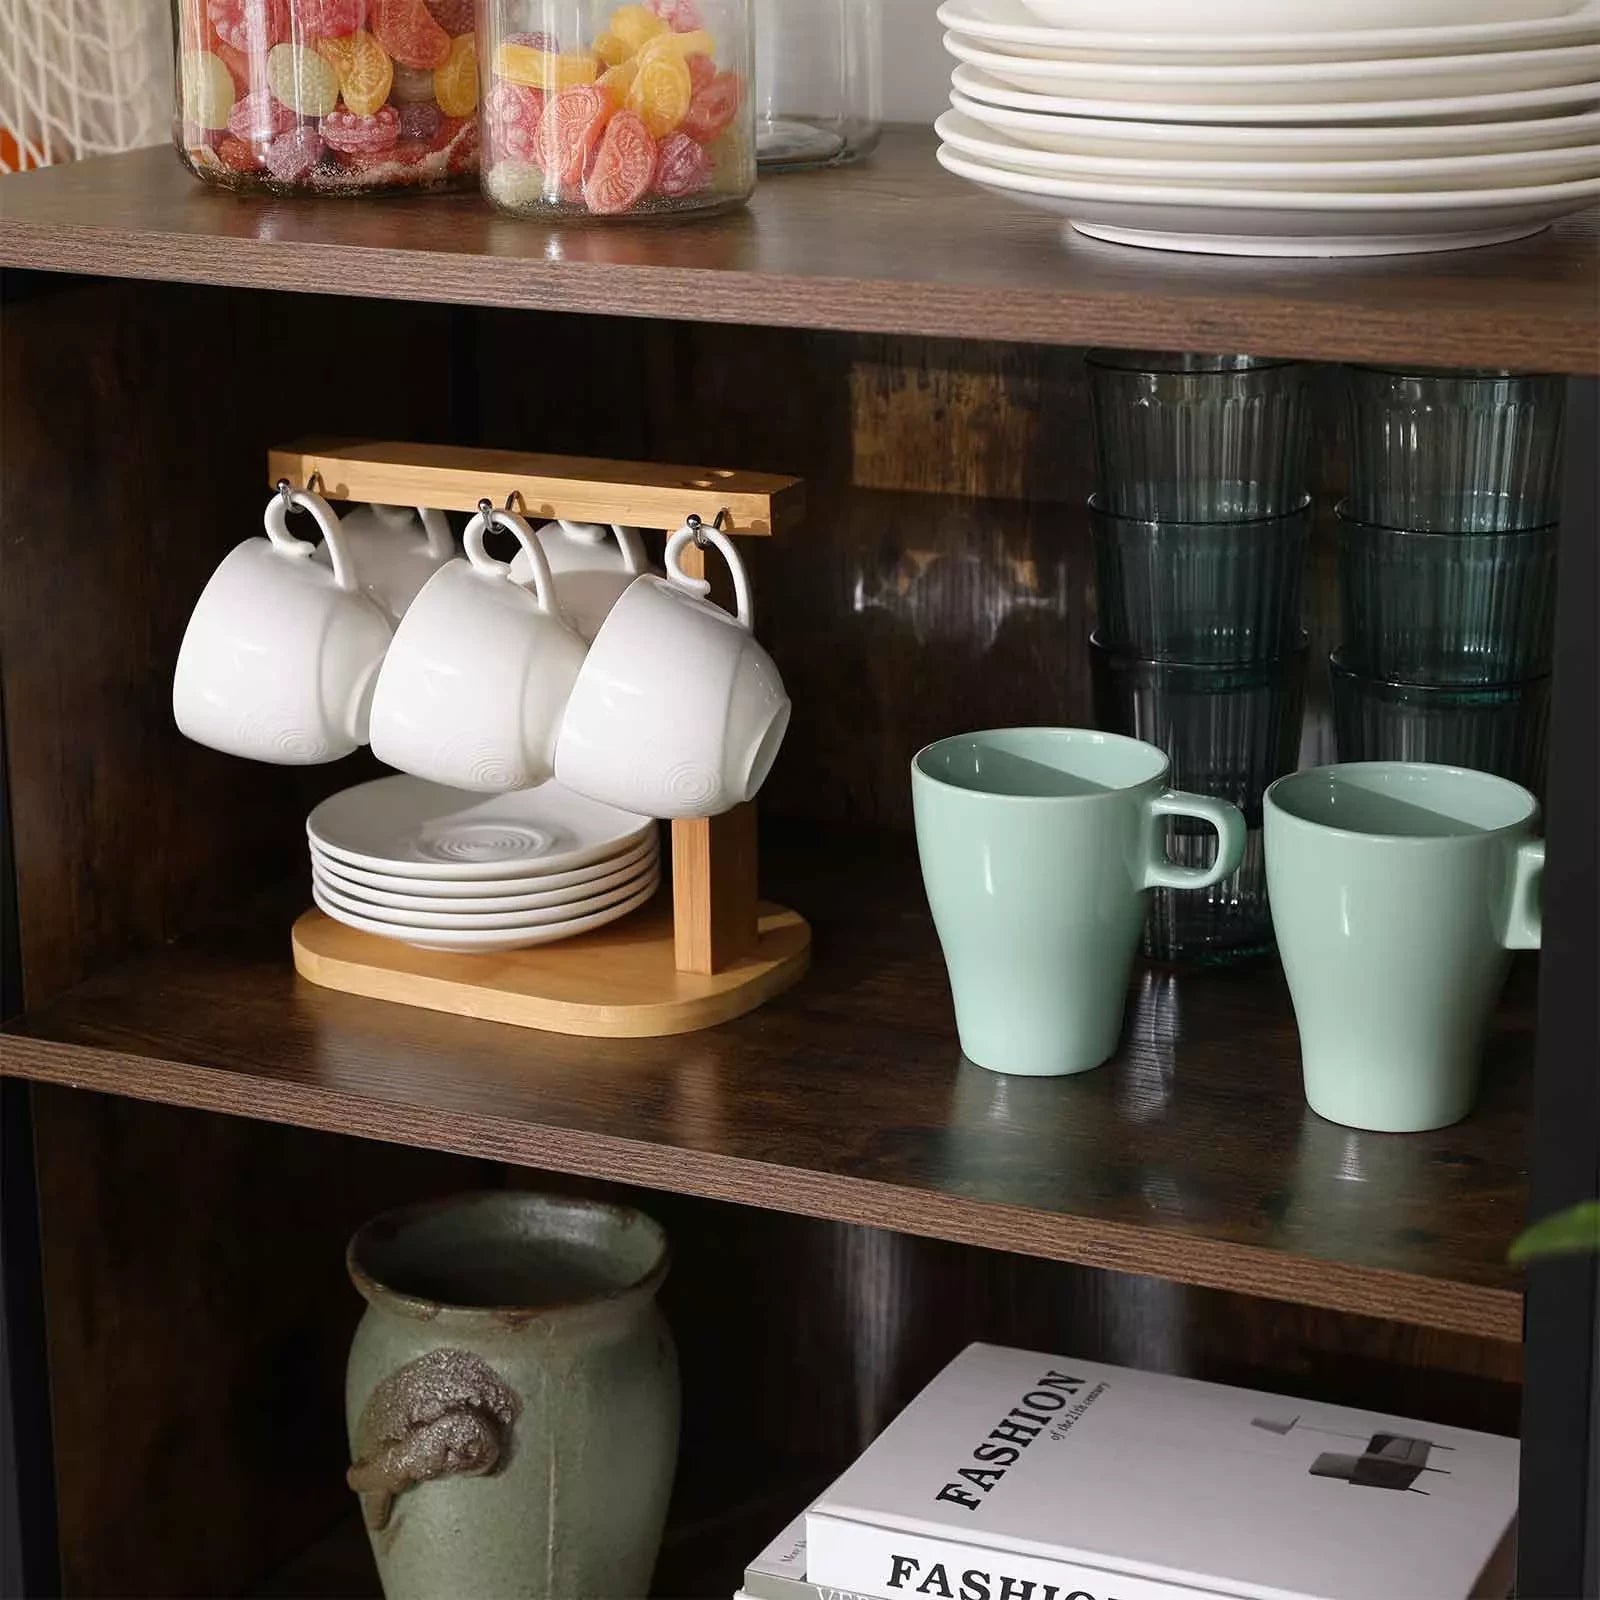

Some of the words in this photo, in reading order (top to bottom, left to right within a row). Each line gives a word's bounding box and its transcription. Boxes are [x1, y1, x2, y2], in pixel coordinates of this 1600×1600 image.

[1050, 1430, 1066, 1441] of
[1057, 1419, 1074, 1432] the
[935, 1370, 1086, 1511] FASHION
[886, 1554, 1121, 1600] FASHI
